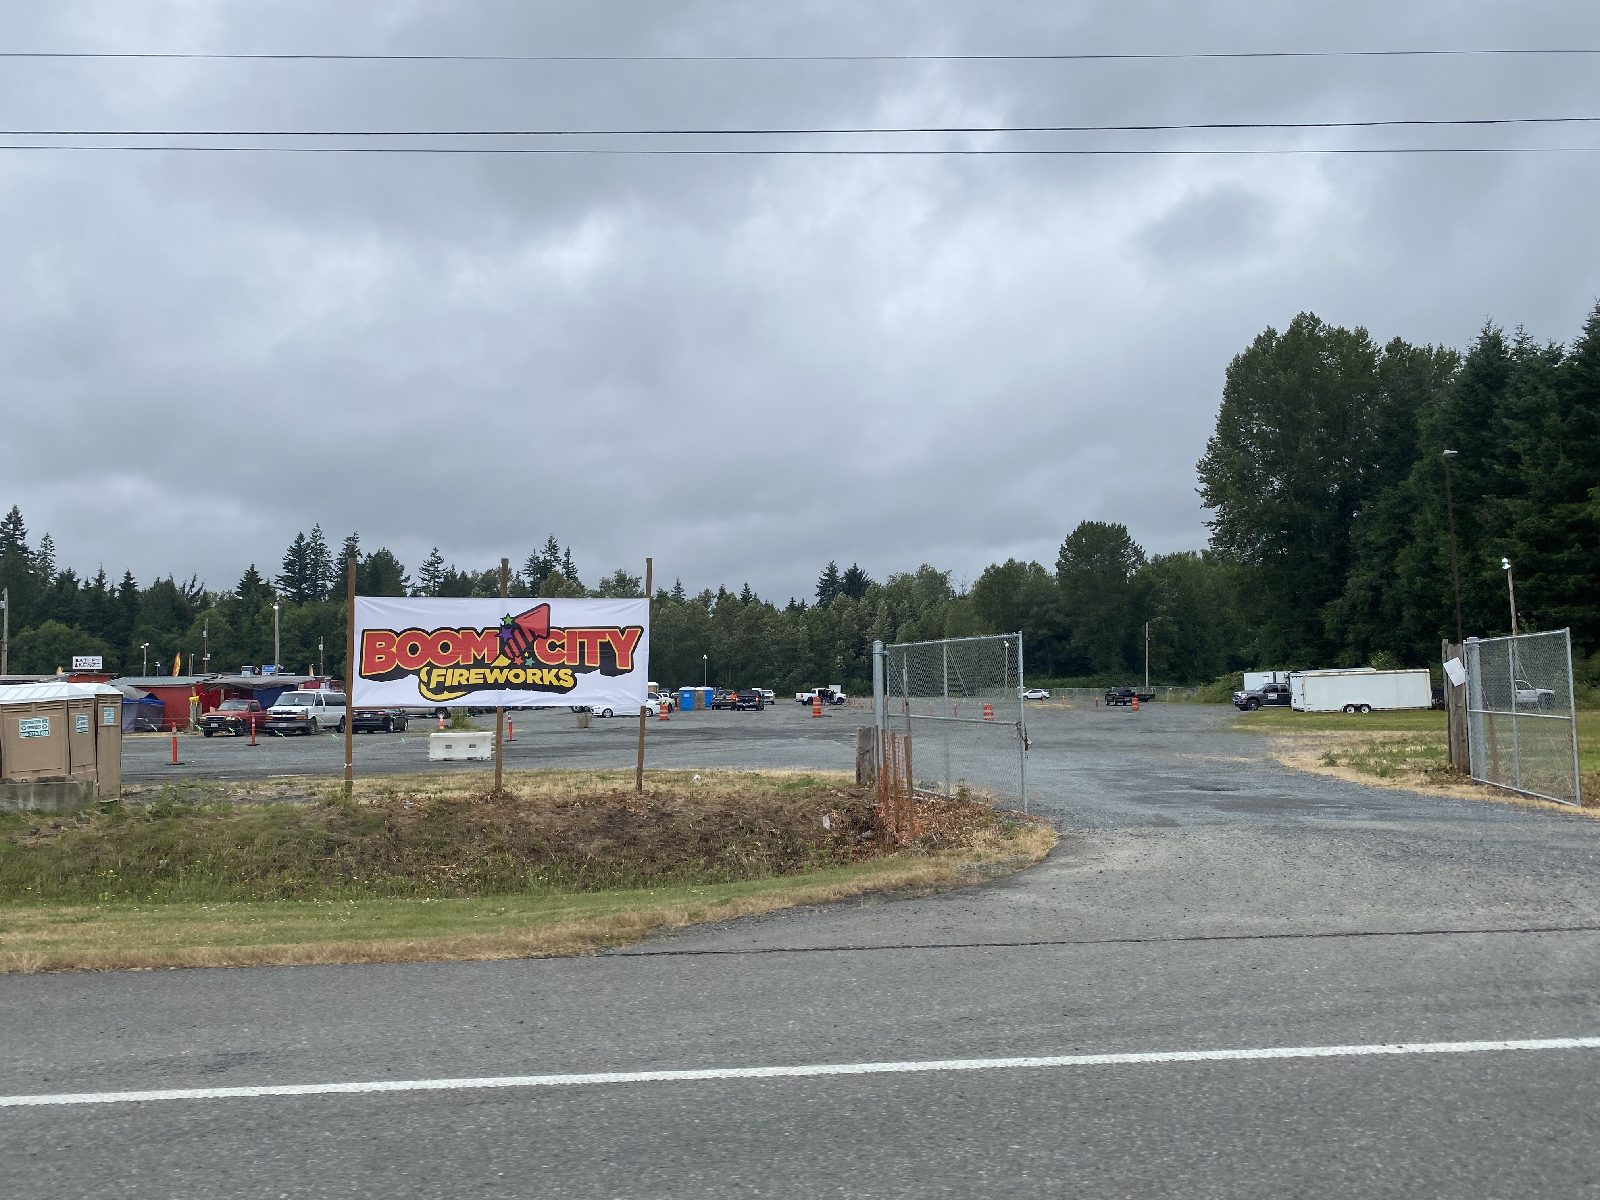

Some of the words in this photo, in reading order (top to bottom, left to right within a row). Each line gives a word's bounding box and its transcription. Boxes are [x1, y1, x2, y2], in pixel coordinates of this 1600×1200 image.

[360, 628, 500, 677] BOOM
[535, 628, 643, 671] CITY
[428, 666, 576, 689] FIREWORKS
